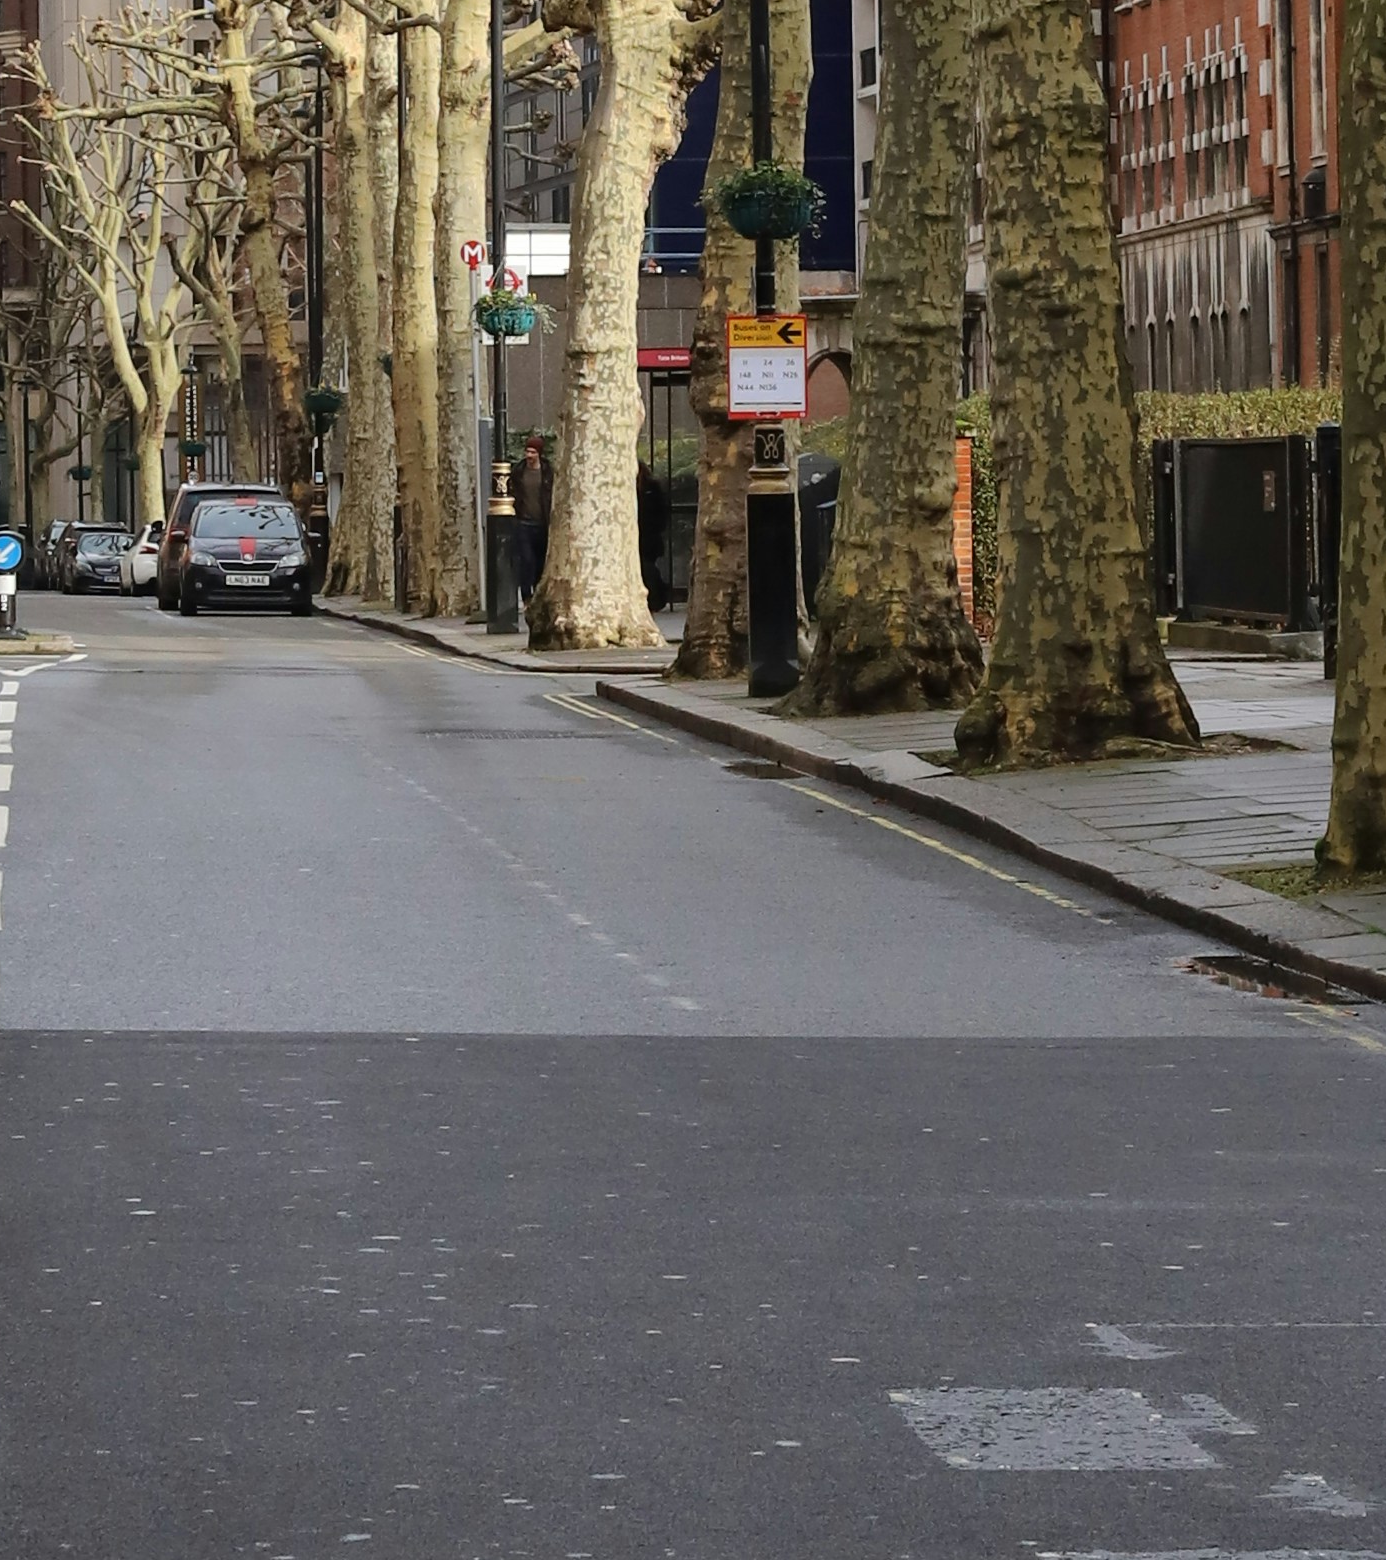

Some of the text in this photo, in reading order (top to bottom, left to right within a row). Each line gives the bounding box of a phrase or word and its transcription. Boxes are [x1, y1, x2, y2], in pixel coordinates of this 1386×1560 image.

[463, 244, 482, 263] M
[733, 323, 758, 332] Buses
[733, 333, 773, 342] Diversion
